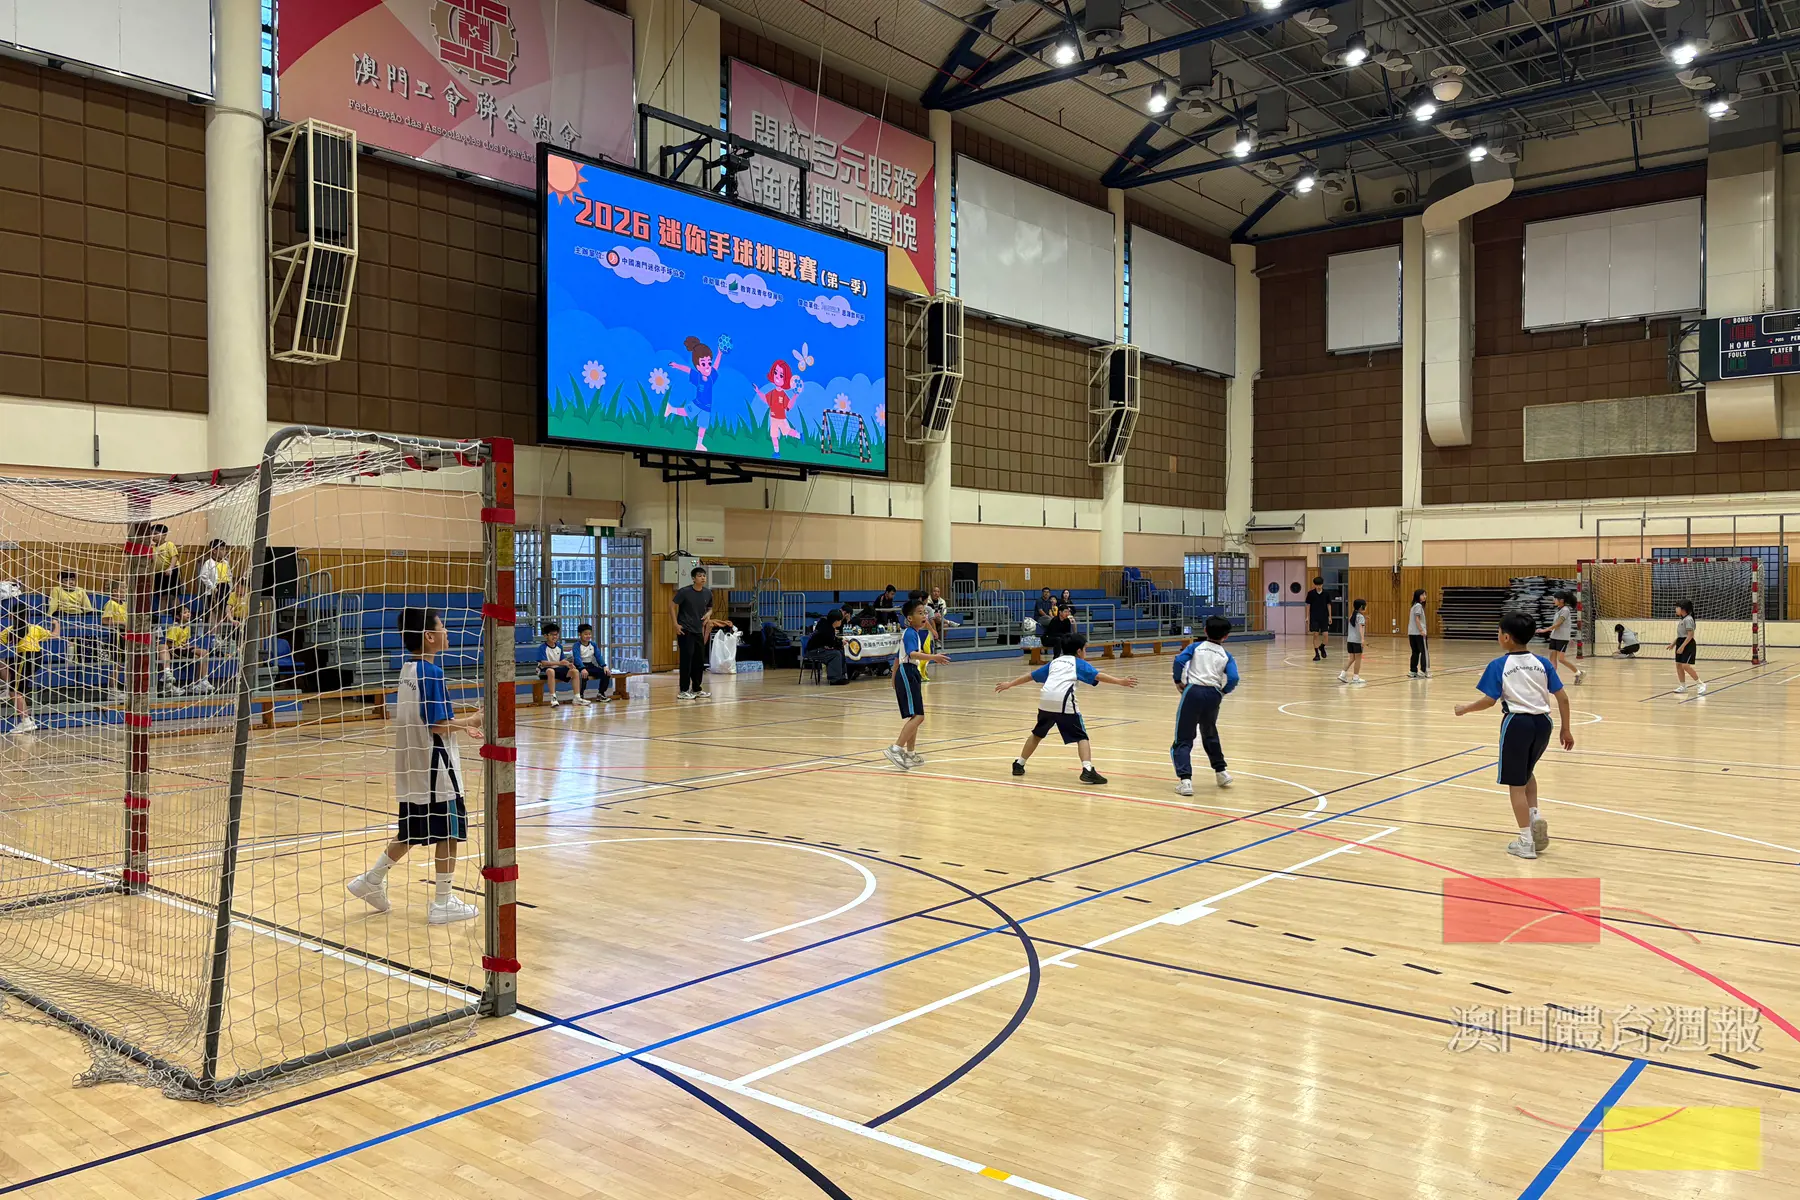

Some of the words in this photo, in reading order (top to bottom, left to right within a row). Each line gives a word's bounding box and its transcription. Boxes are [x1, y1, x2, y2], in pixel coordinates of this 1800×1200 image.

[347, 98, 404, 124] Federação
[405, 115, 423, 130] das
[483, 138, 501, 152] dos
[352, 52, 582, 150] 澳門工會聯合總會
[574, 195, 652, 242] 2026
[657, 214, 819, 286] 迷你手球挑戰賽
[819, 269, 868, 298] (第一季)
[750, 163, 919, 253] 強健職工體魄
[1733, 316, 1752, 324] BONUS
